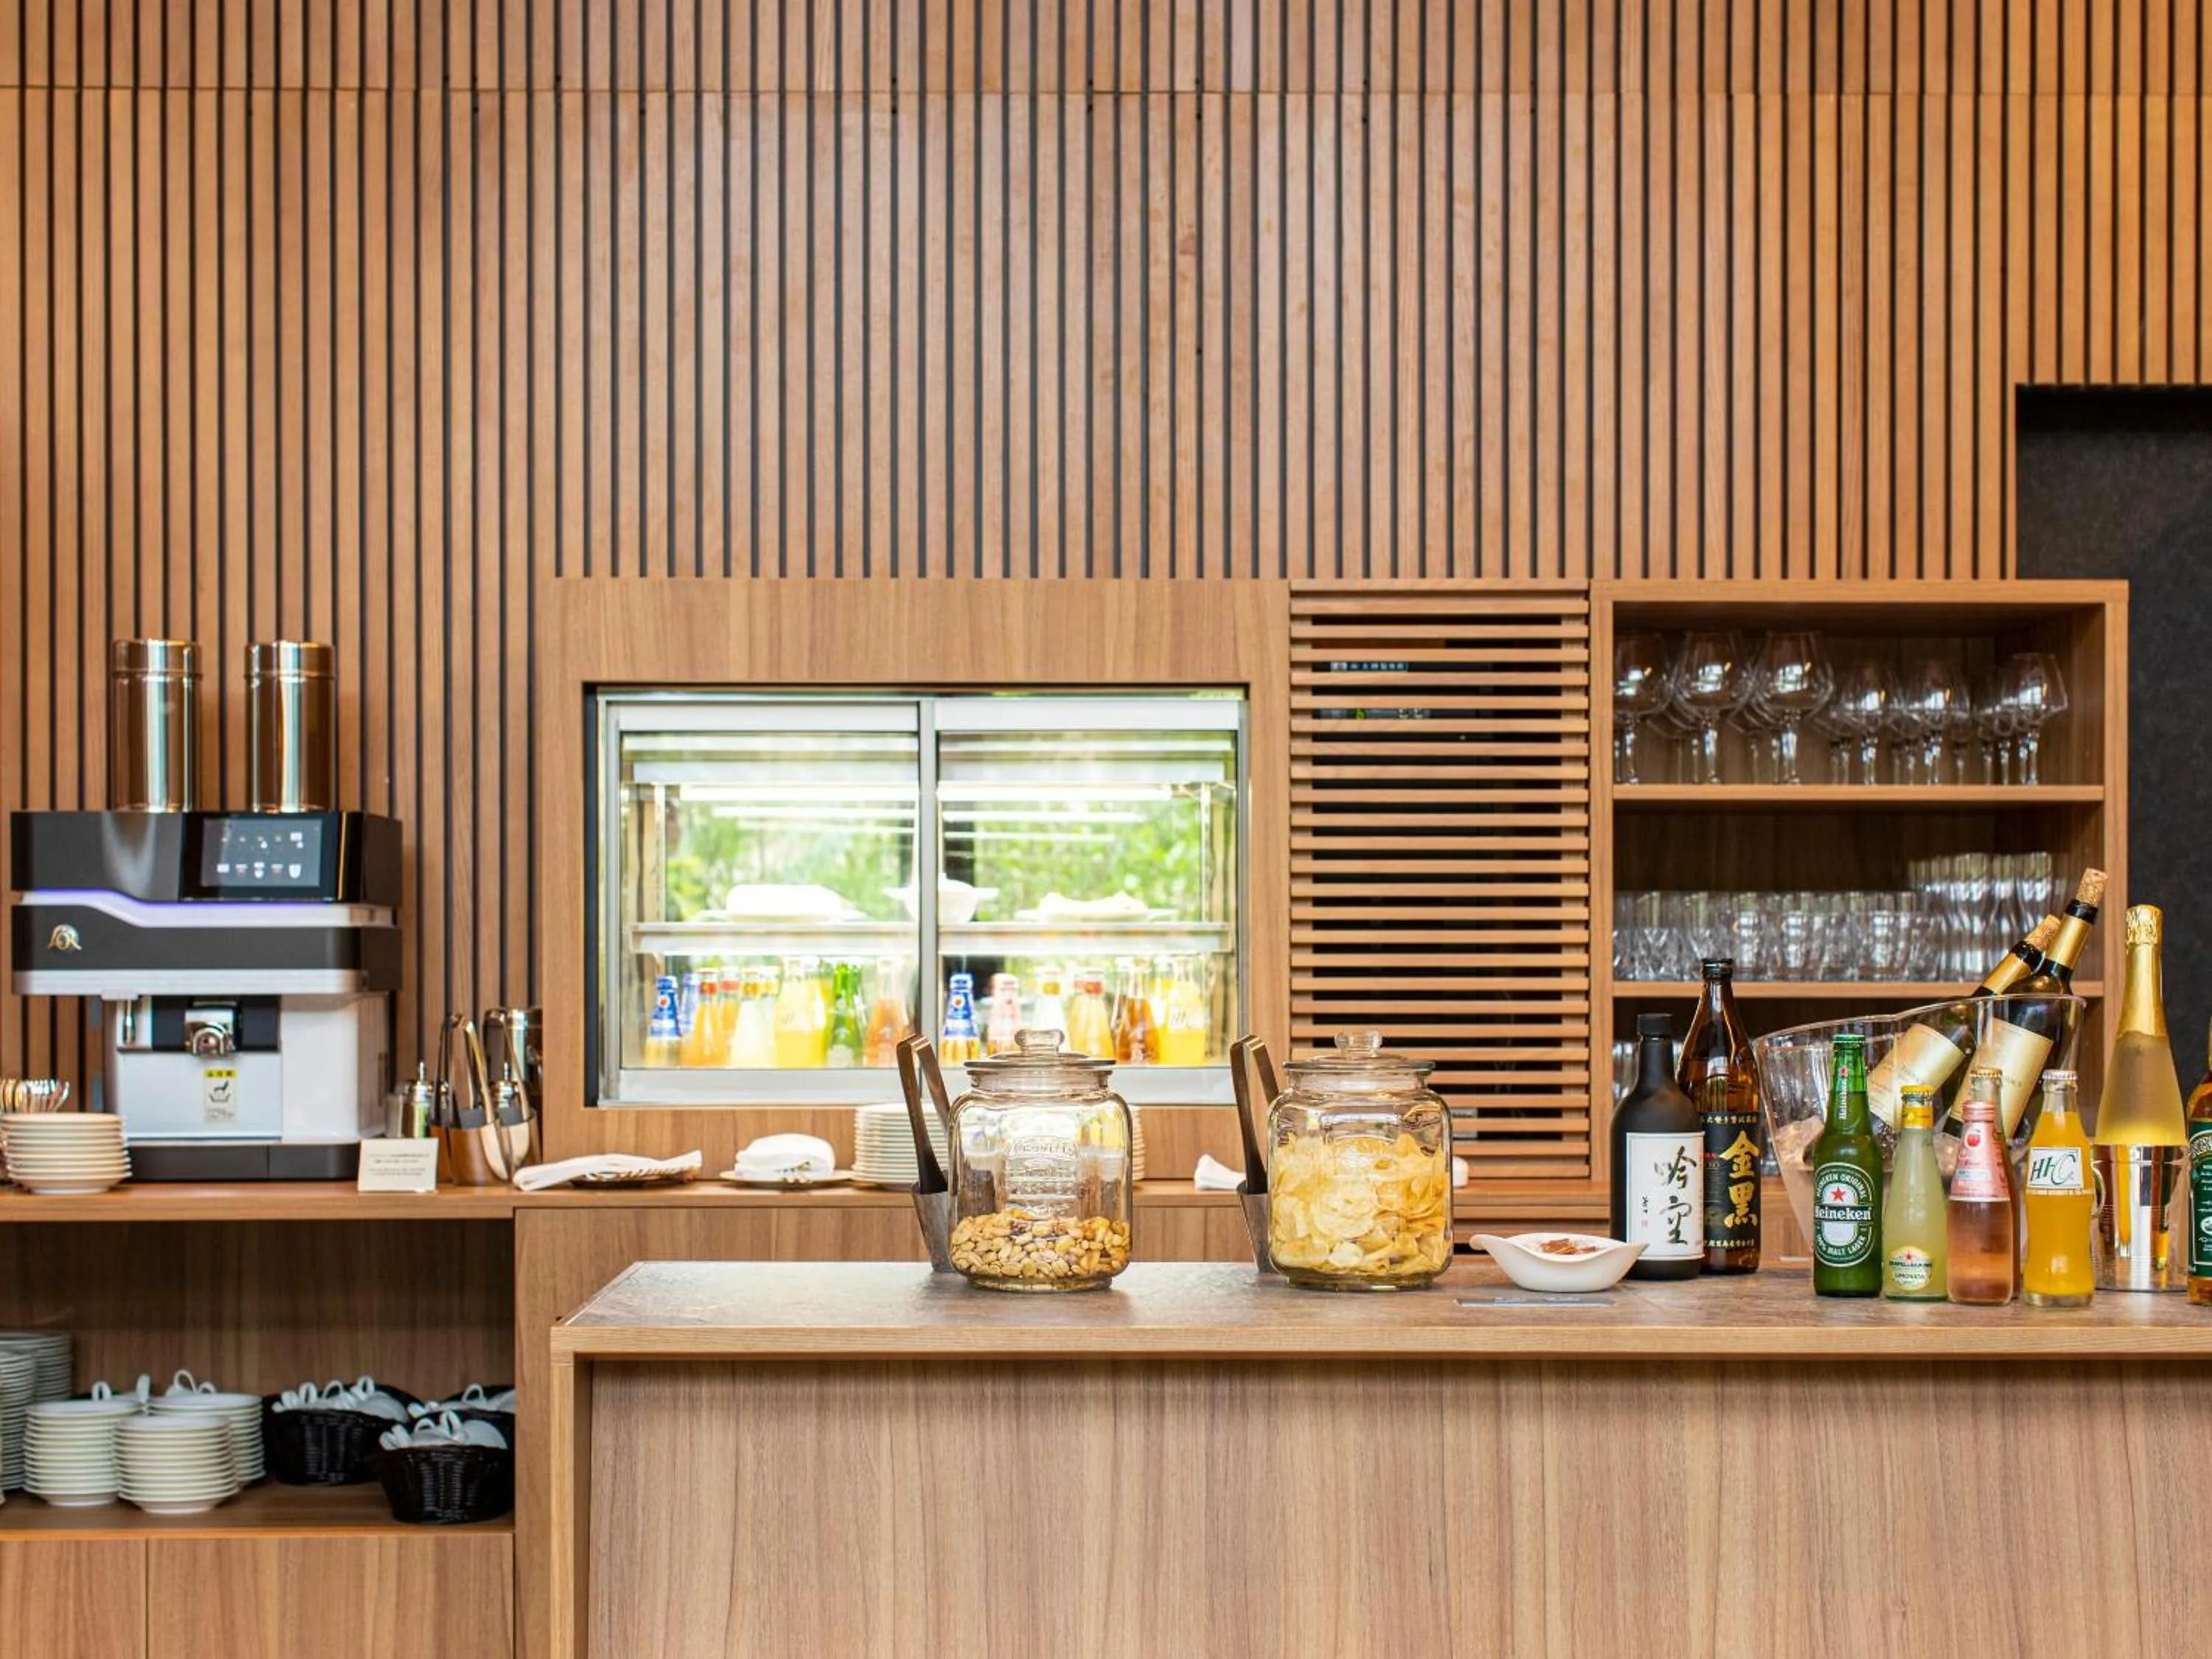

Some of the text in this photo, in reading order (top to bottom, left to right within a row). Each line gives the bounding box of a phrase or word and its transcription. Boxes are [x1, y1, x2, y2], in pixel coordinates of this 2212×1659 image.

[1719, 1130, 1760, 1228] 金黒
[1826, 1246, 1846, 1256] MALT
[1846, 1234, 1867, 1254] LAGER
